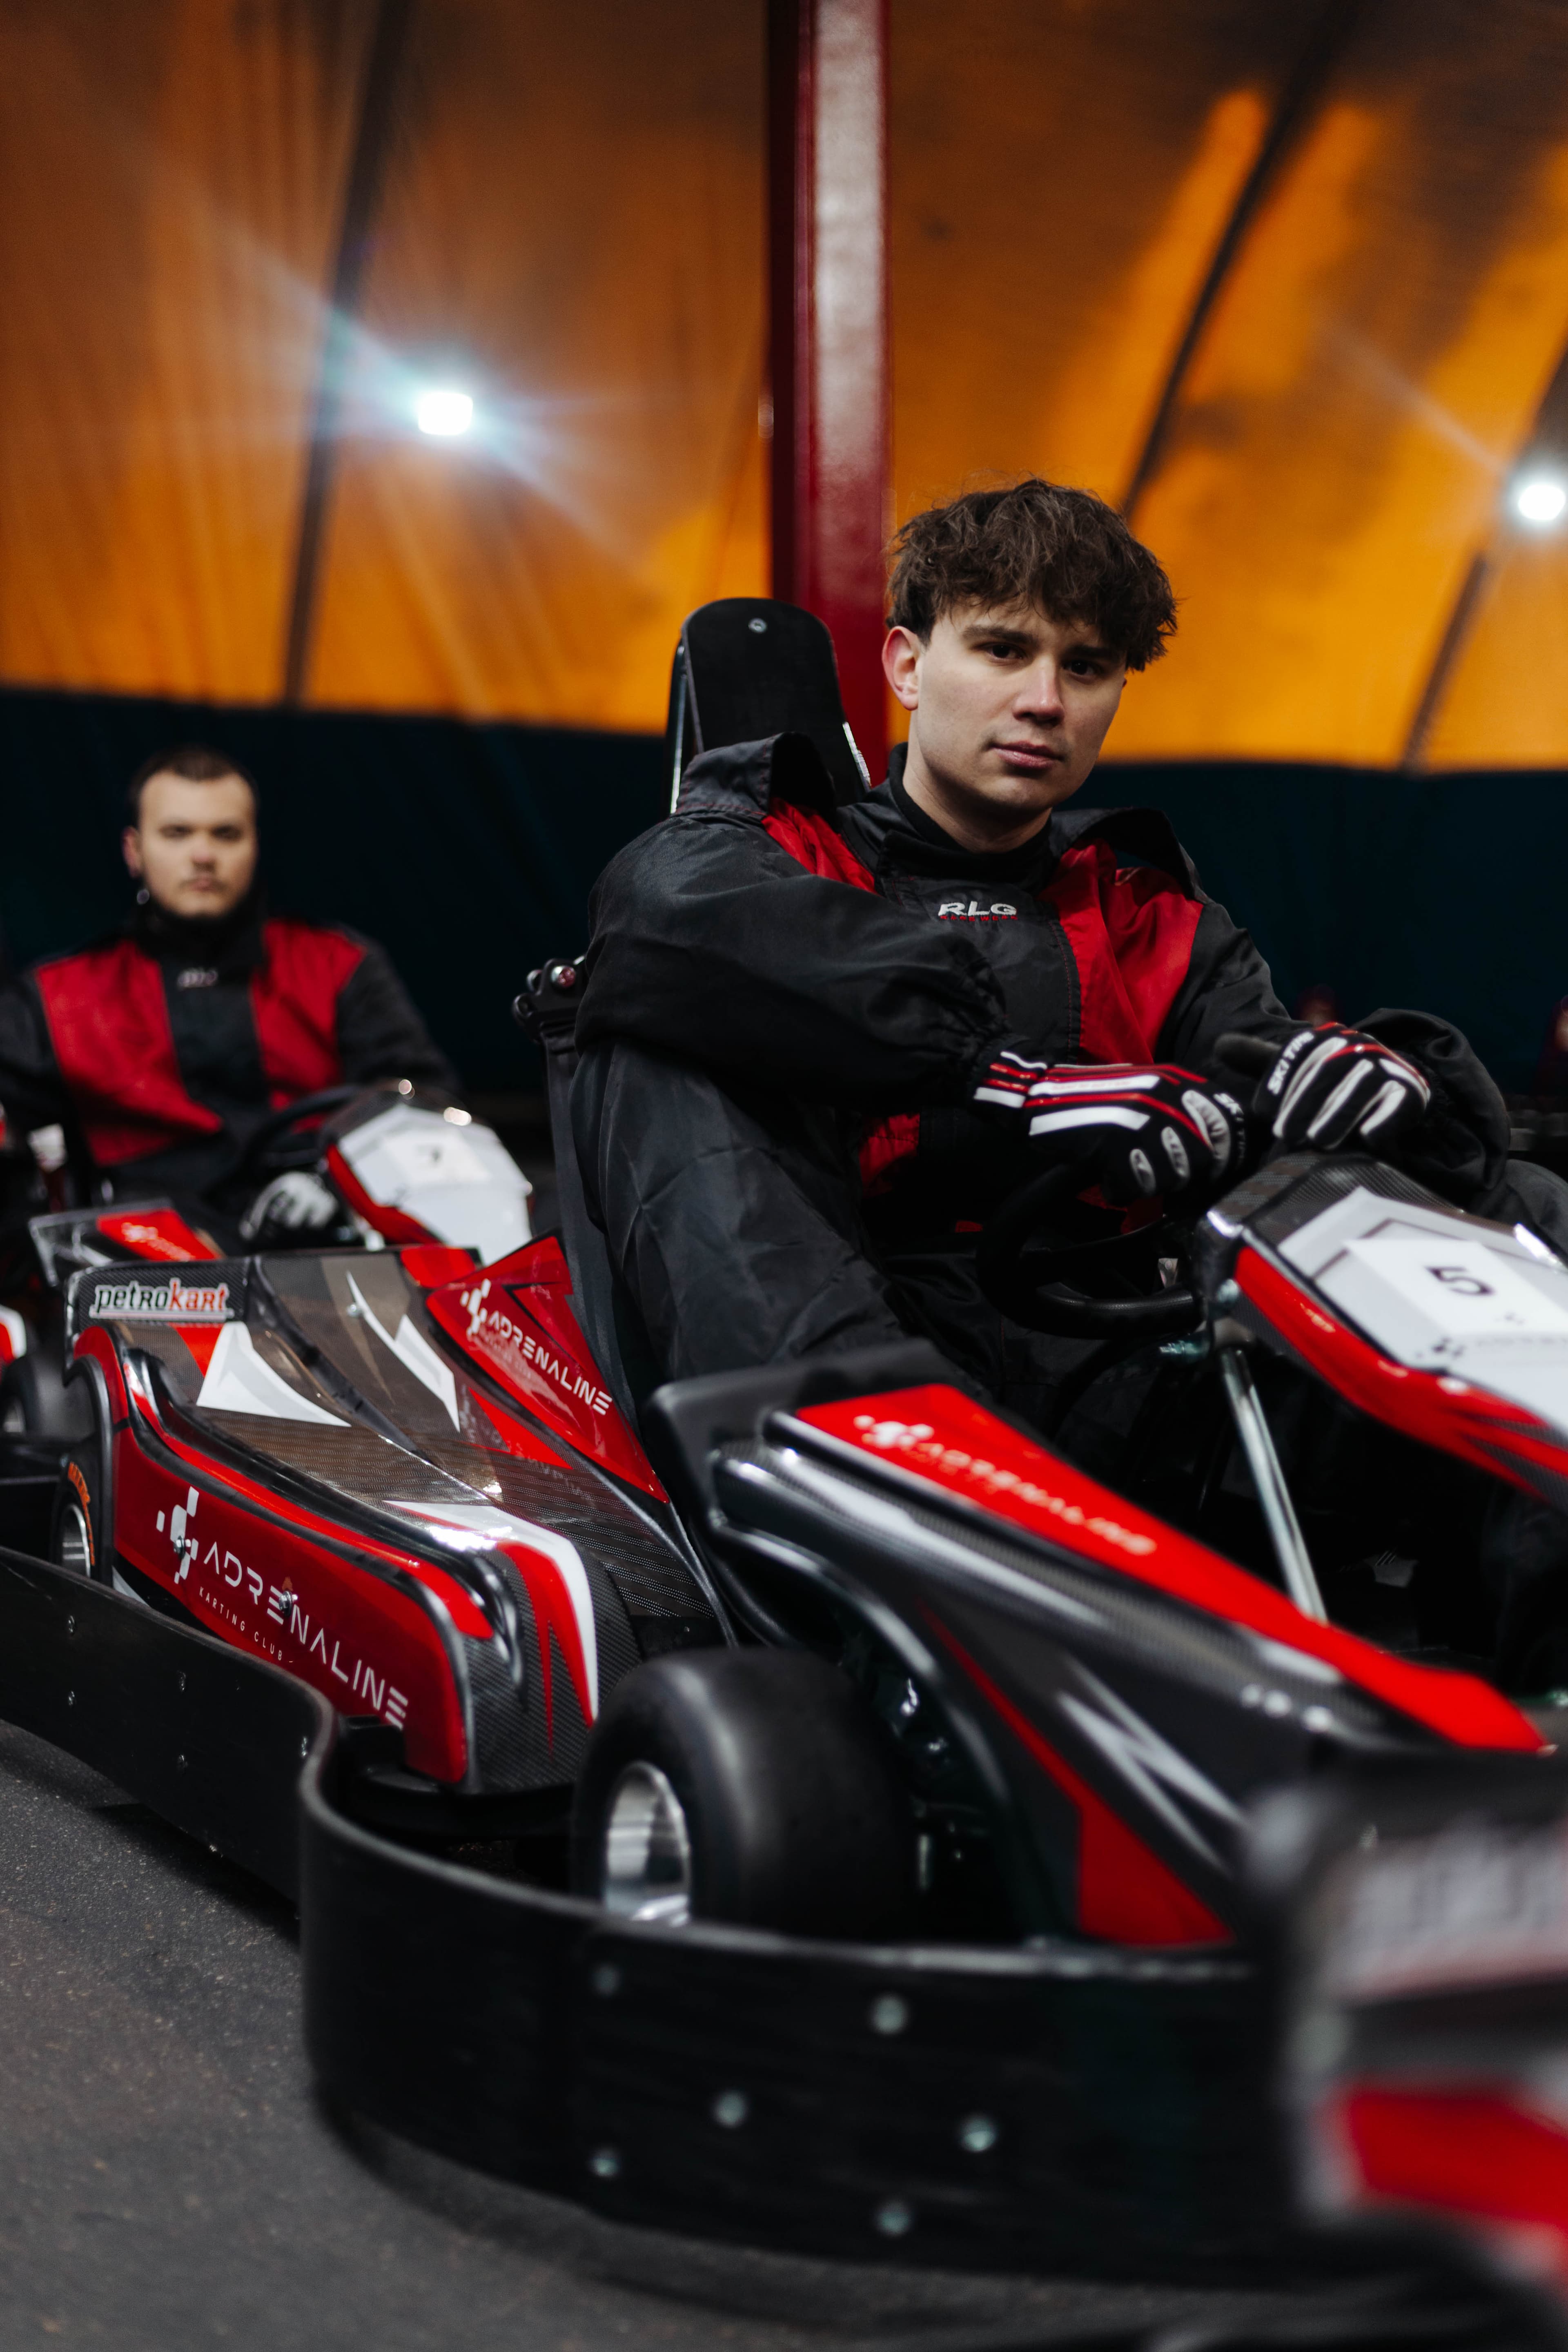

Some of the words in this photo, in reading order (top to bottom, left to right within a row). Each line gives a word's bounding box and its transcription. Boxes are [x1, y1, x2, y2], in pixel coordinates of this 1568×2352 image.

[938, 901, 1017, 916] RLG
[1267, 1058, 1290, 1094] SKI
[1425, 1266, 1495, 1296] 5
[489, 1310, 613, 1416] ADRENALINE
[199, 1586, 245, 1631] KARTING
[254, 1631, 283, 1661] CLUB
[204, 1541, 408, 1730] ADRENALINE
